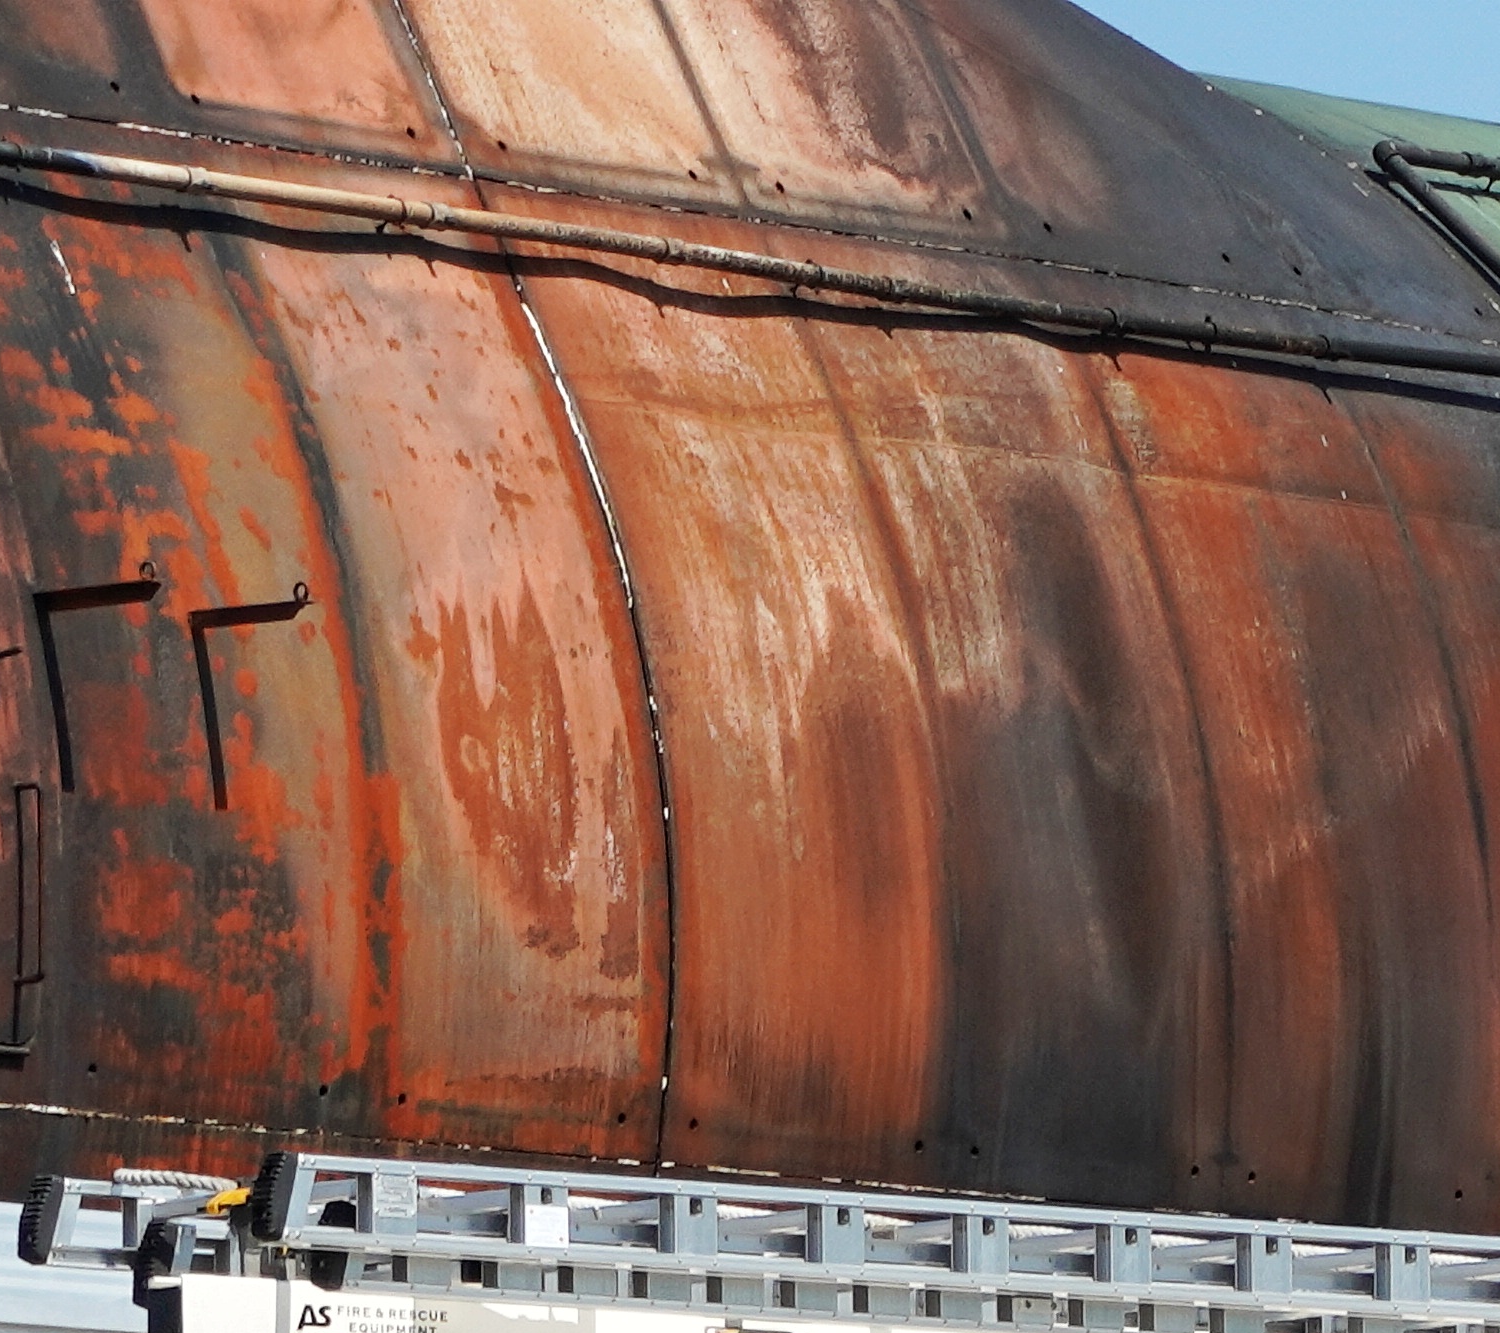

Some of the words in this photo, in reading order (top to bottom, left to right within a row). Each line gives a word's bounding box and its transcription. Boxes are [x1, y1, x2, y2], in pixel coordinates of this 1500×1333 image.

[297, 1304, 332, 1331] AS
[337, 1305, 371, 1318] FIRE
[376, 1307, 384, 1318] &
[389, 1309, 448, 1323] RESCUE
